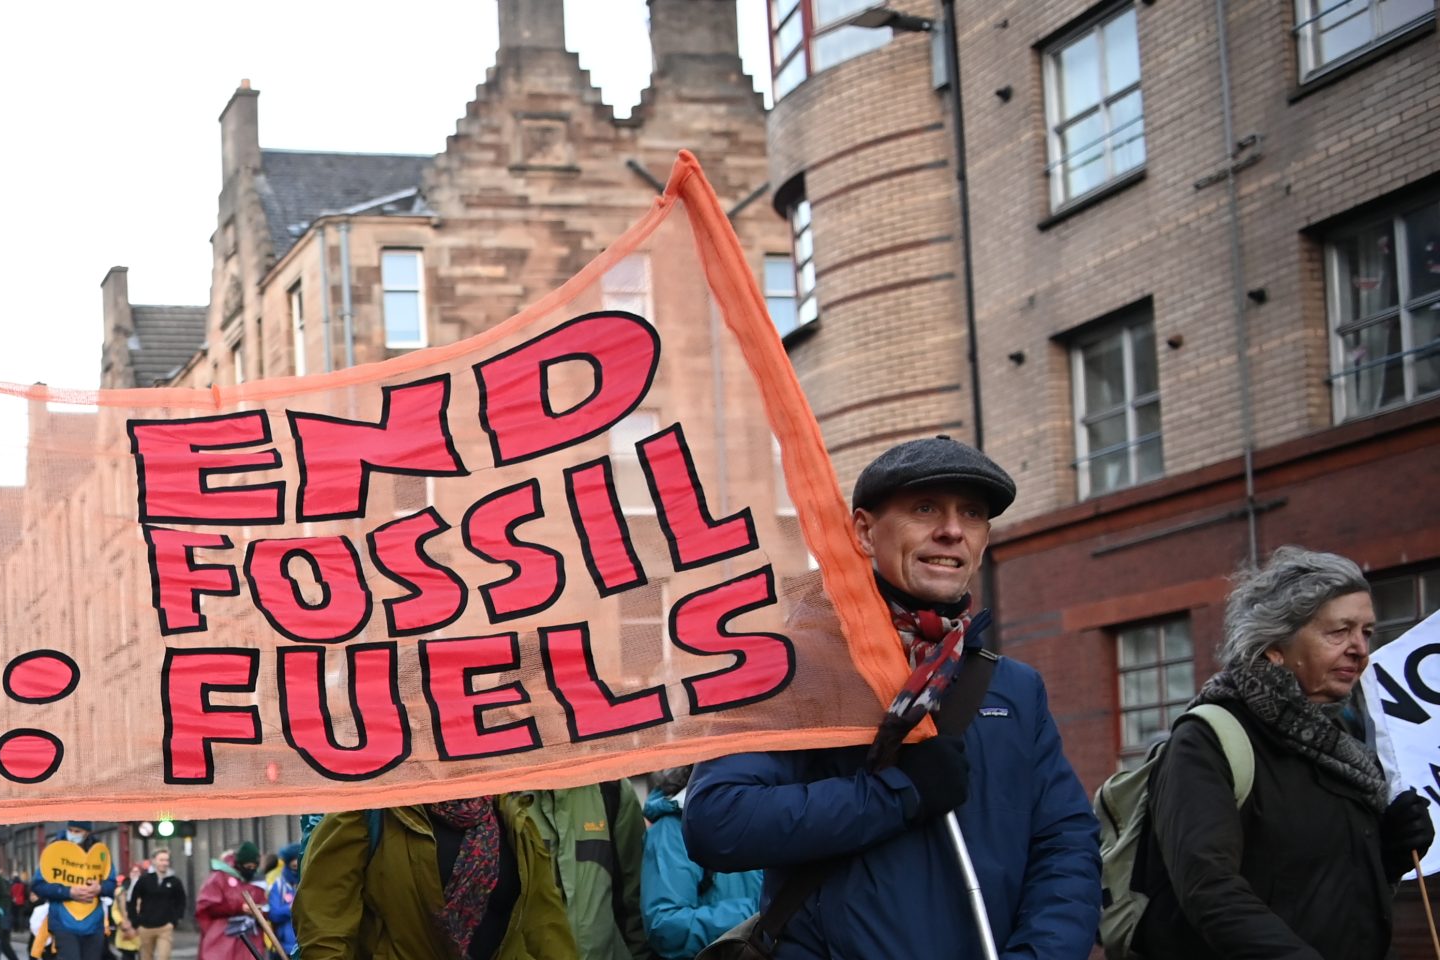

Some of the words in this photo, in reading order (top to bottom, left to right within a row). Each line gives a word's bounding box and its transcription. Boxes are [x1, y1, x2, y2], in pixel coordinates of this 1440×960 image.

[126, 309, 662, 525] END
[142, 421, 760, 643] FOSSIL
[161, 563, 796, 785] FUELS
[61, 858, 91, 870] There's
